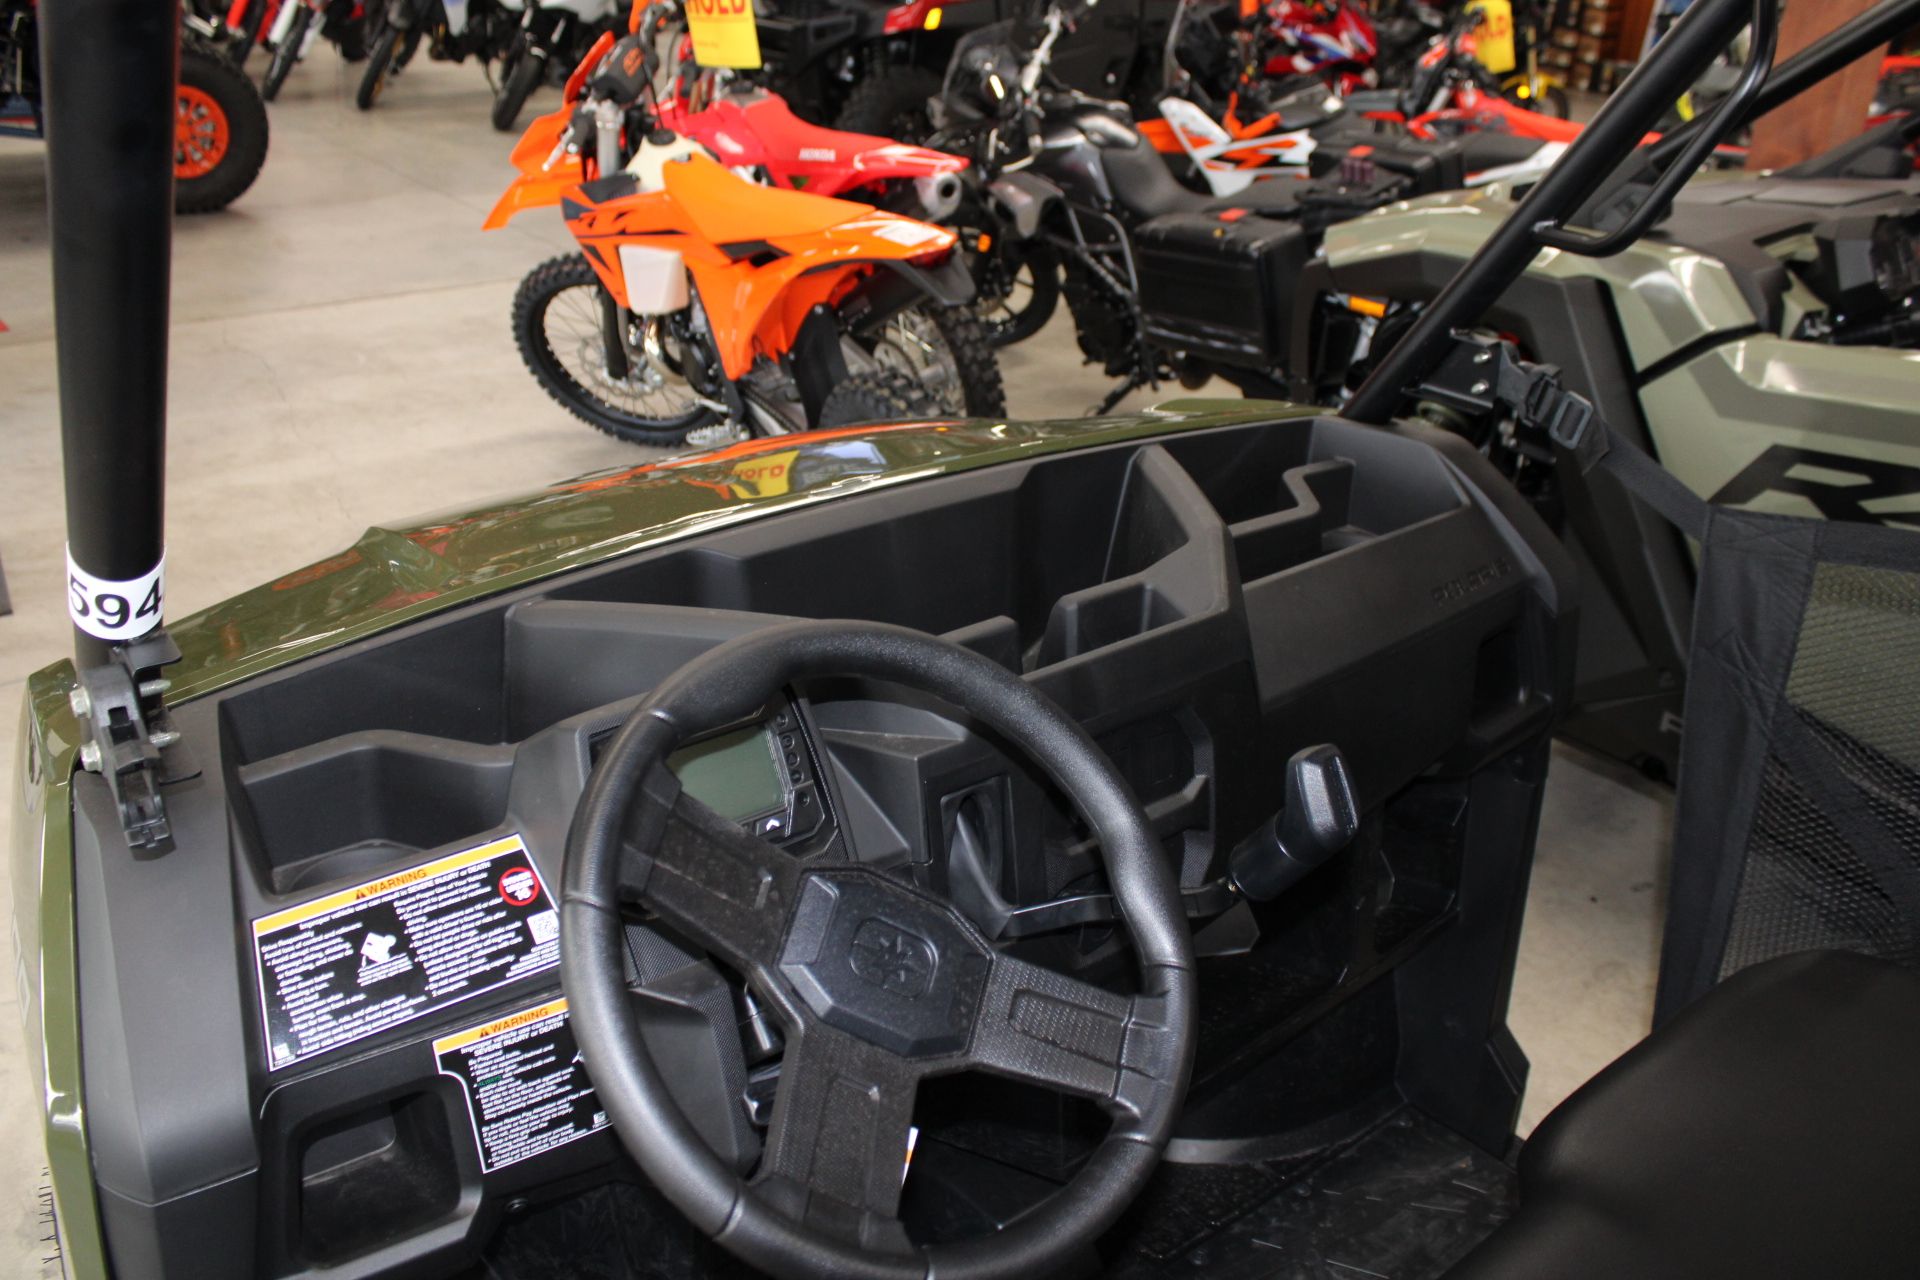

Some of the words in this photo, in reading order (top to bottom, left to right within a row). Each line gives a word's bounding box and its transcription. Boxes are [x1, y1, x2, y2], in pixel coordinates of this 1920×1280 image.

[70, 573, 162, 629] 594
[367, 869, 427, 895] WARNING
[491, 1008, 548, 1032] WARNING
